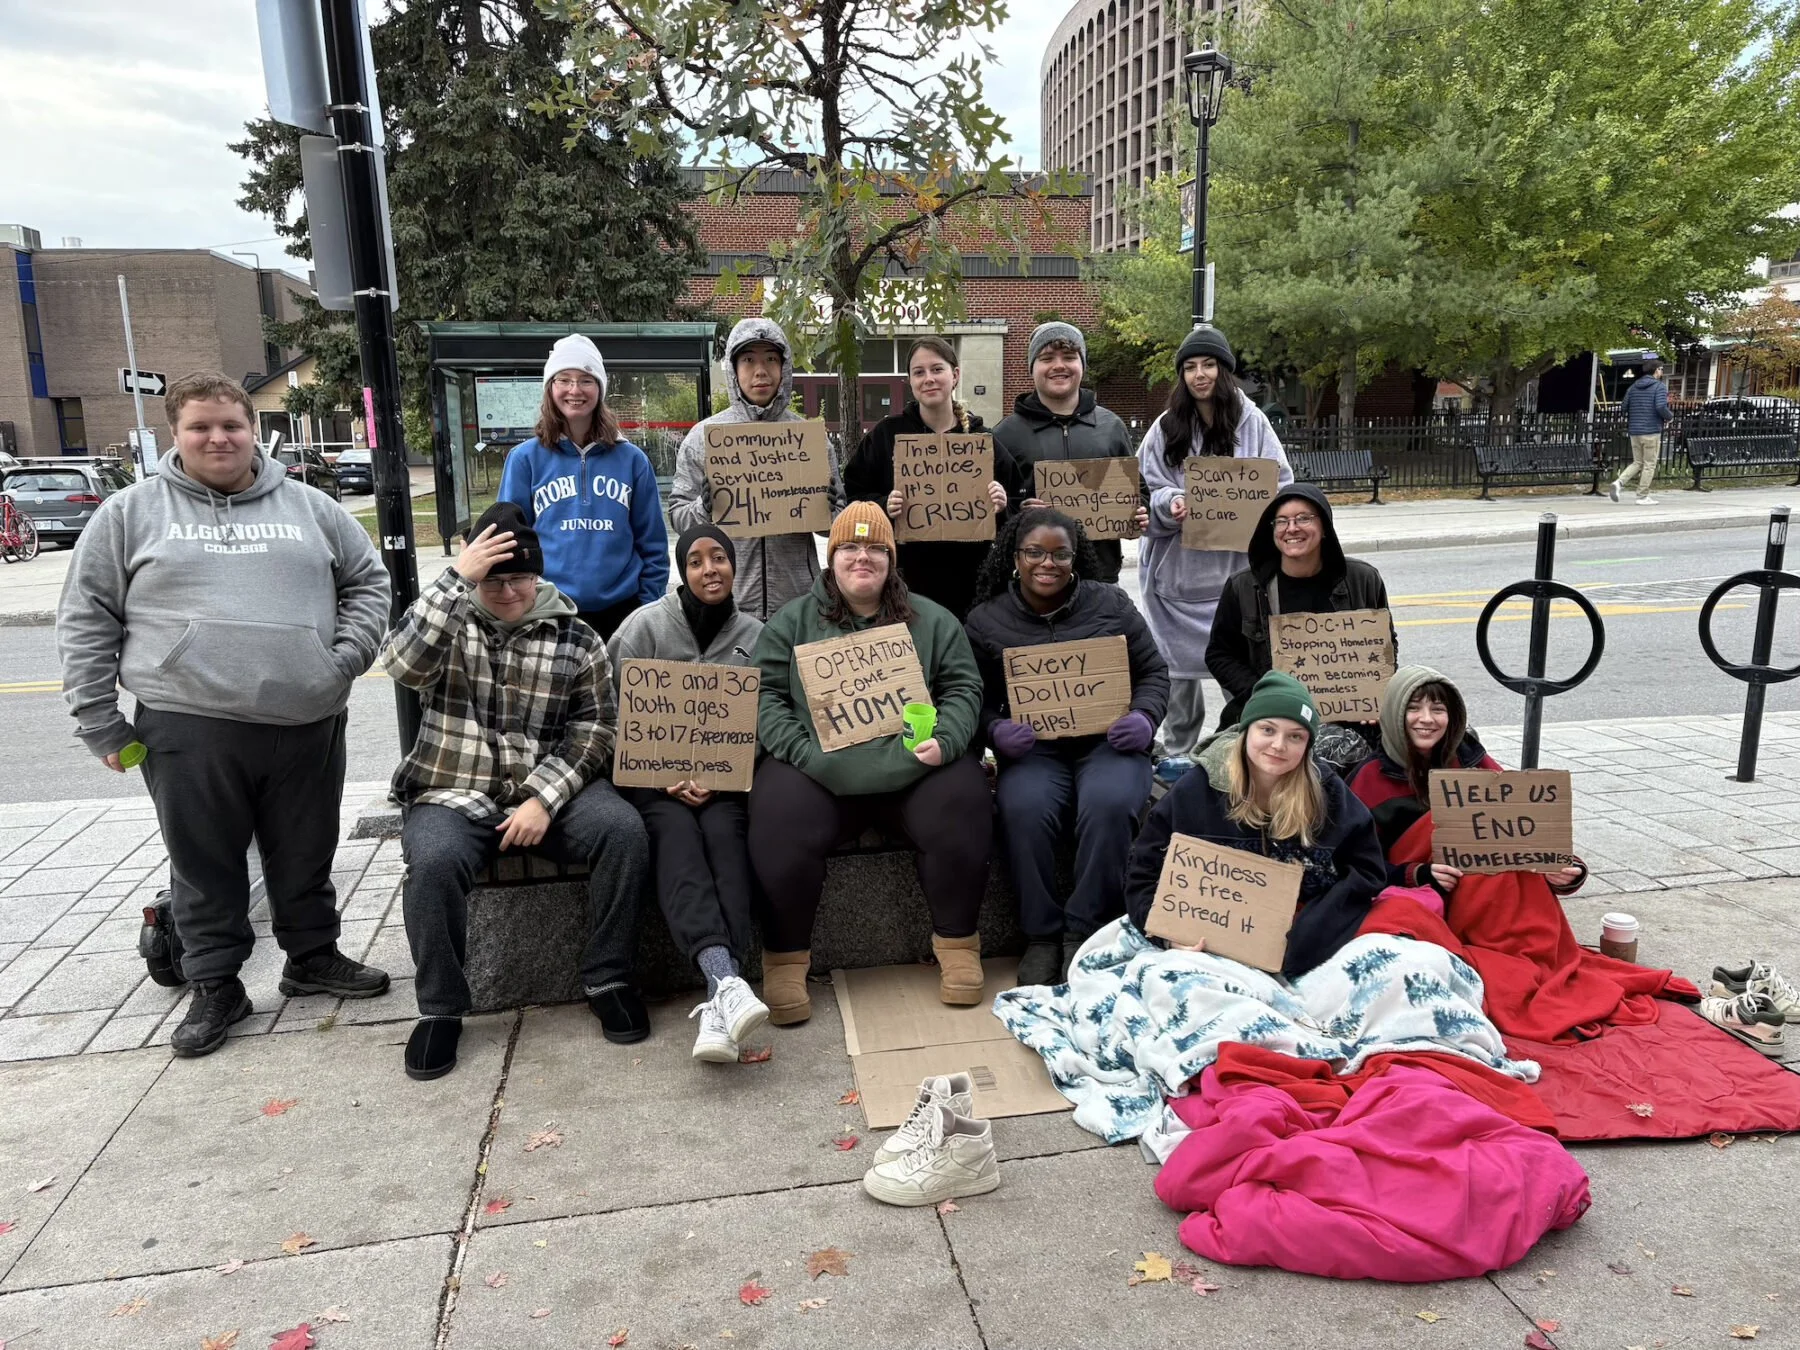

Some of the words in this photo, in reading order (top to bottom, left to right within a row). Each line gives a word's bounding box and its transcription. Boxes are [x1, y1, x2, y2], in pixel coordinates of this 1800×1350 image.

[708, 428, 804, 450] Community
[897, 439, 938, 458] This
[710, 452, 741, 466] and
[747, 450, 810, 467] Justice
[901, 463, 911, 477] a
[913, 459, 982, 479] choice,
[712, 470, 783, 486] Services
[1189, 462, 1233, 483] Scan
[1238, 465, 1259, 481] to
[904, 481, 935, 500] It's
[947, 482, 959, 494] a
[1191, 485, 1223, 503] give.
[790, 497, 810, 519] of
[906, 499, 988, 530] CRISIS
[1190, 507, 1203, 521] to
[167, 522, 303, 542] ALGONQUIN
[560, 518, 614, 531] JUNIOR
[1084, 517, 1094, 527] a
[204, 543, 269, 554] COLLEGE
[1280, 638, 1337, 653] Stopping
[1340, 637, 1384, 648] Homeless
[814, 639, 914, 679] OPERATION
[1009, 653, 1086, 677] Every
[1311, 651, 1359, 666] YOUTH
[626, 666, 671, 689] One
[682, 672, 718, 690] and
[724, 672, 759, 696] 30
[1307, 685, 1358, 694] Homeless
[1014, 680, 1105, 705] Dollar
[624, 690, 675, 714] Youth
[684, 700, 729, 725] ages
[1317, 697, 1380, 717] DULTS!
[624, 721, 643, 743] 13
[647, 724, 666, 741] to
[670, 725, 688, 744] 17
[619, 751, 733, 773] Homelessness
[1440, 779, 1514, 808] HELP
[1529, 784, 1557, 803] US
[1472, 811, 1536, 841] END
[1172, 844, 1267, 887] Kindness
[1442, 846, 1573, 868] HOMELESSNESS
[1199, 876, 1248, 904] free.
[1162, 894, 1230, 928] Spread
